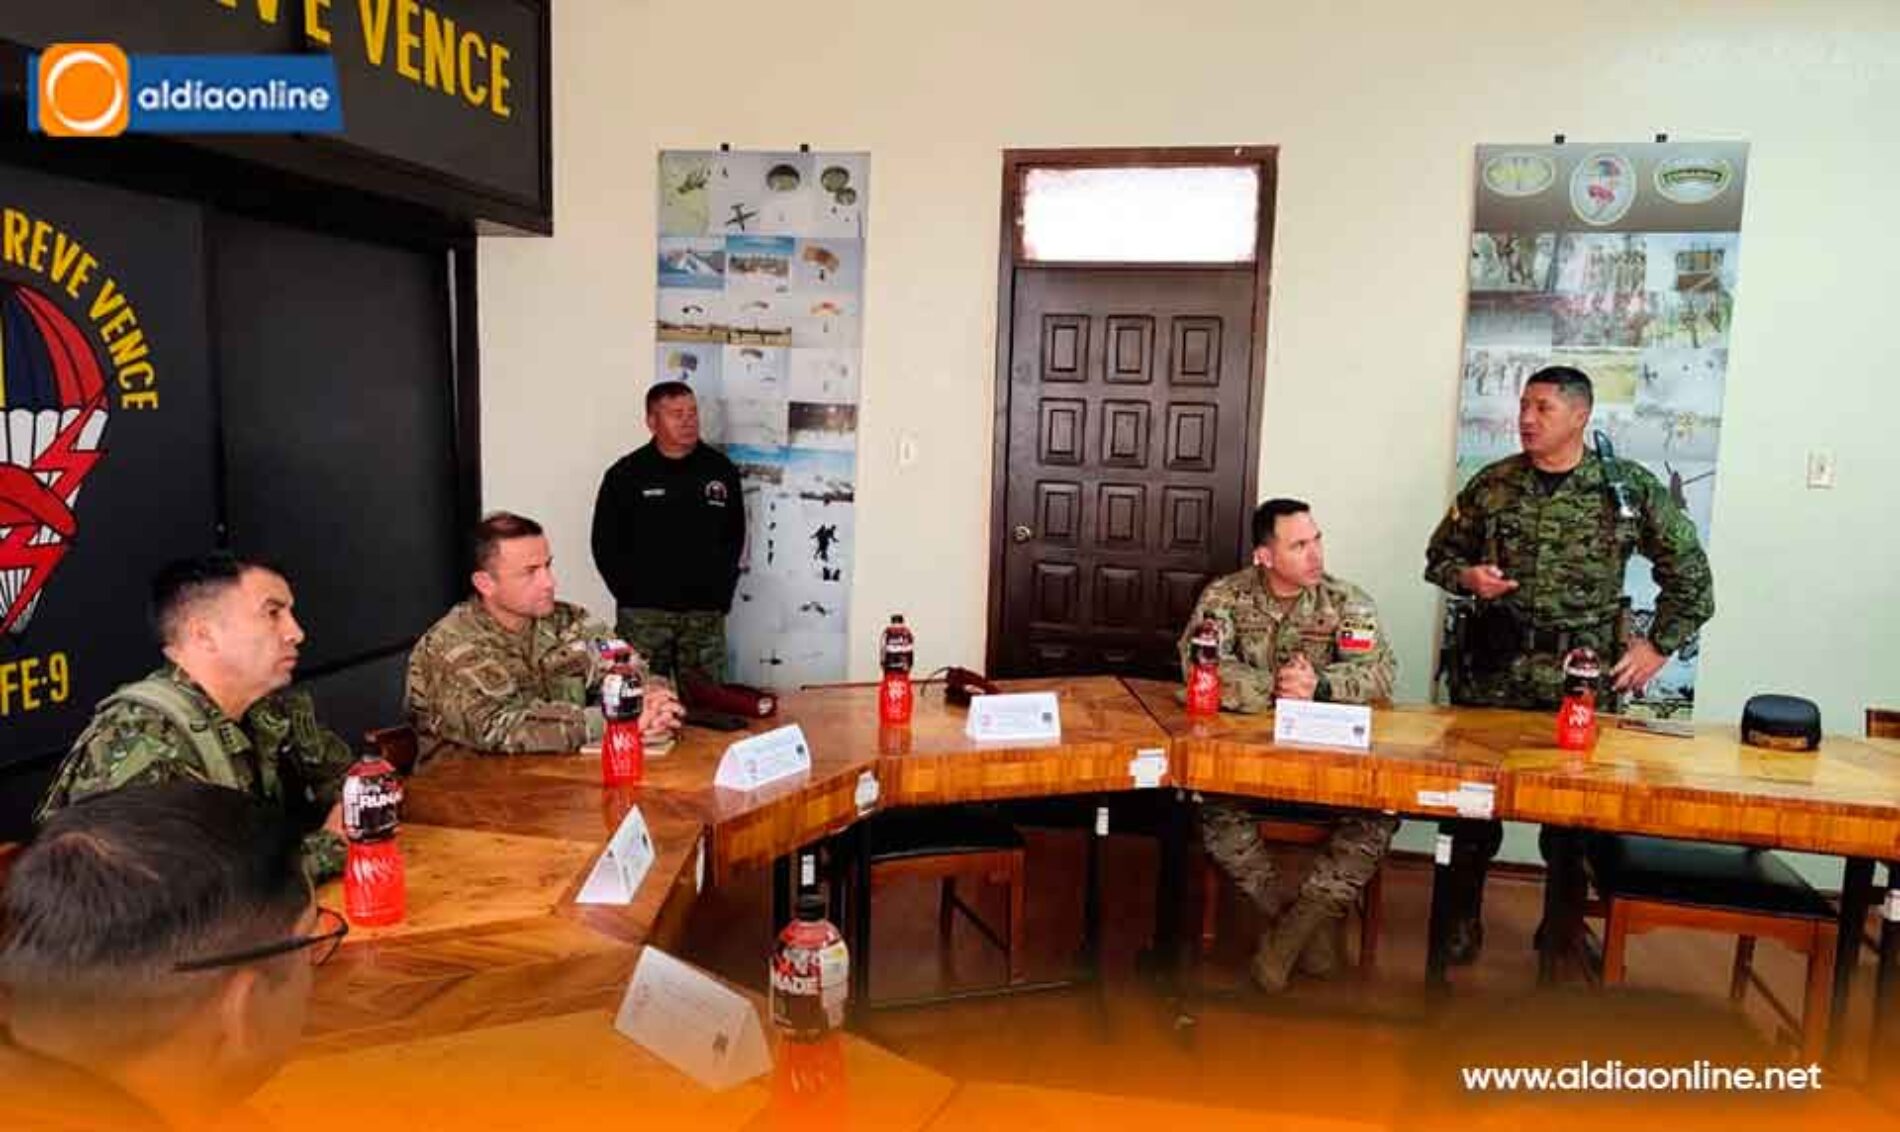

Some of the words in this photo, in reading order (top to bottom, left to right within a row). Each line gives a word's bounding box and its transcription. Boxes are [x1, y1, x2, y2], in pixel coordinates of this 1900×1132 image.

[358, 0, 510, 118] VENCE
[3, 208, 98, 299] REVE
[89, 278, 159, 410] VENCE
